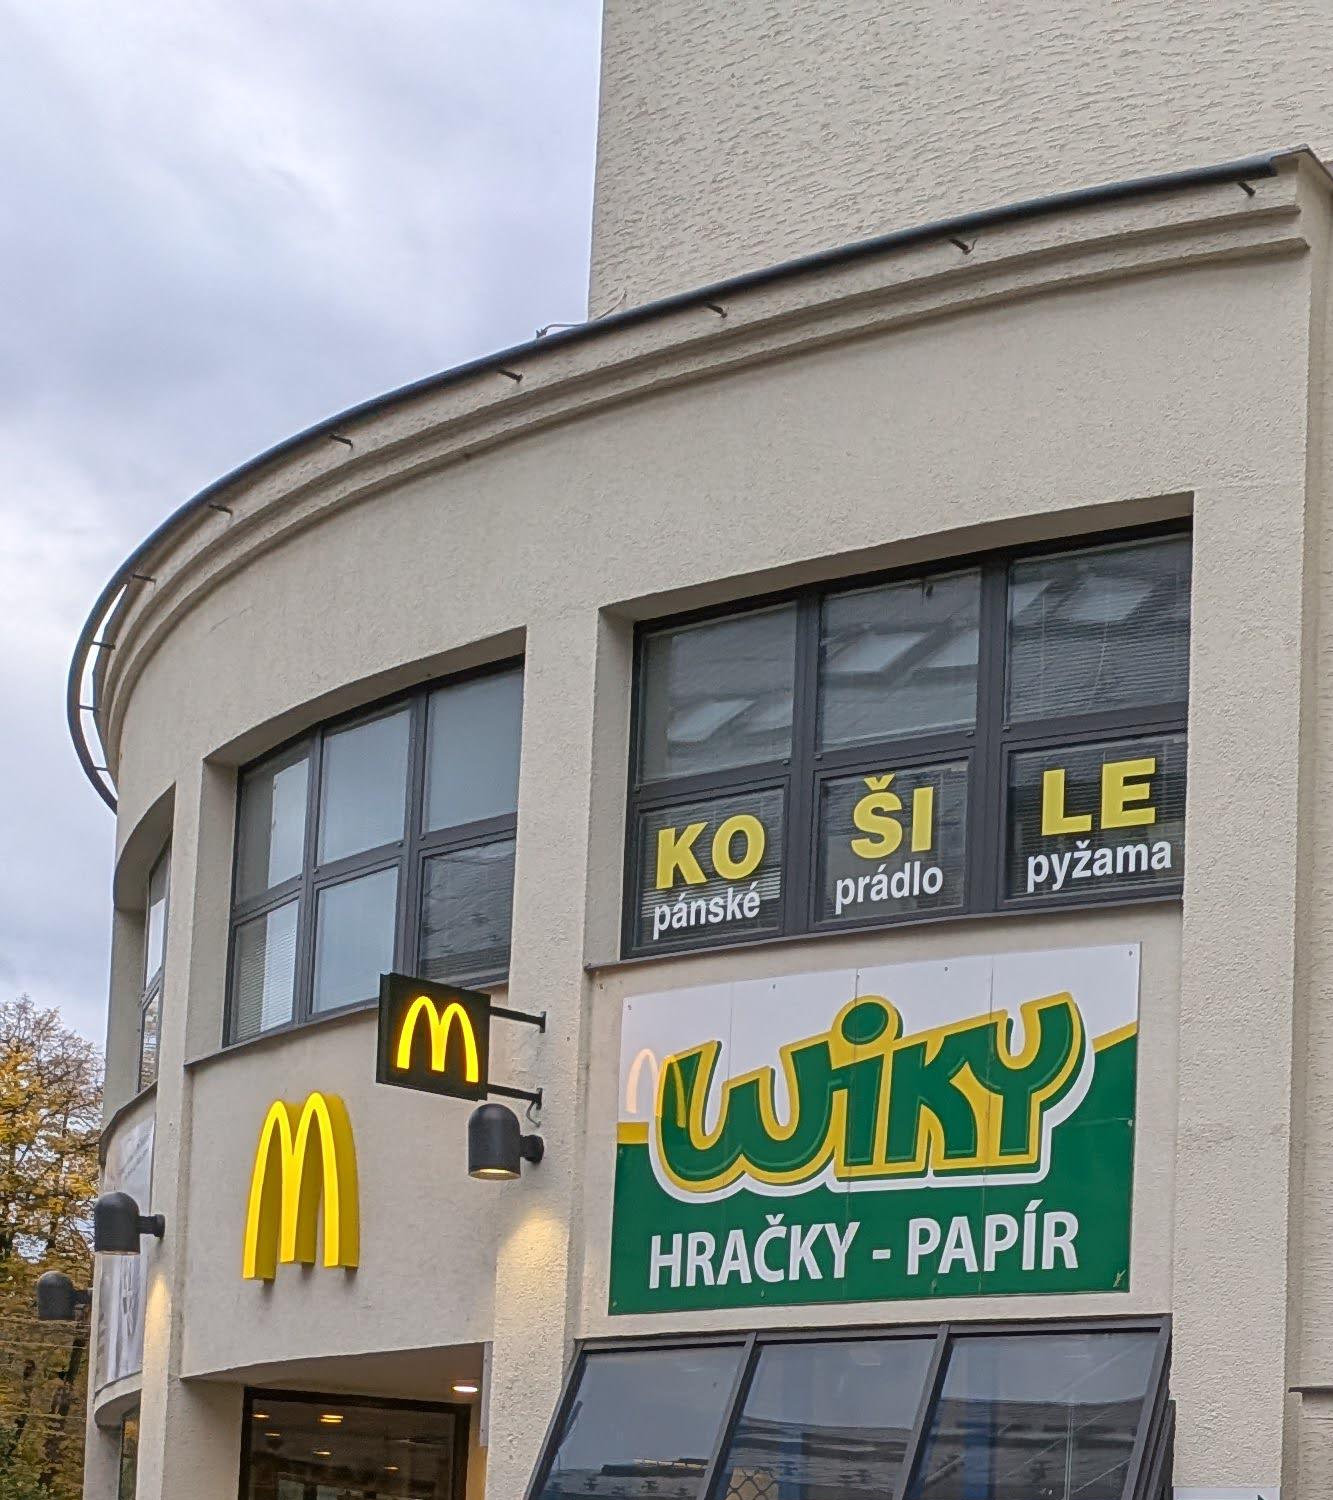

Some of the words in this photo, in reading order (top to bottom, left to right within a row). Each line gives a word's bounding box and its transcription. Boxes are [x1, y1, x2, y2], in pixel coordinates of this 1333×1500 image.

[655, 814, 766, 890] KO
[851, 774, 935, 859] ŠI
[1041, 757, 1157, 836] LE
[652, 883, 761, 940] pánské
[835, 863, 944, 915] prádlo
[1026, 838, 1172, 892] pyžama
[649, 1213, 861, 1290] HRAČKY
[907, 1199, 1080, 1277] PAPÍR
